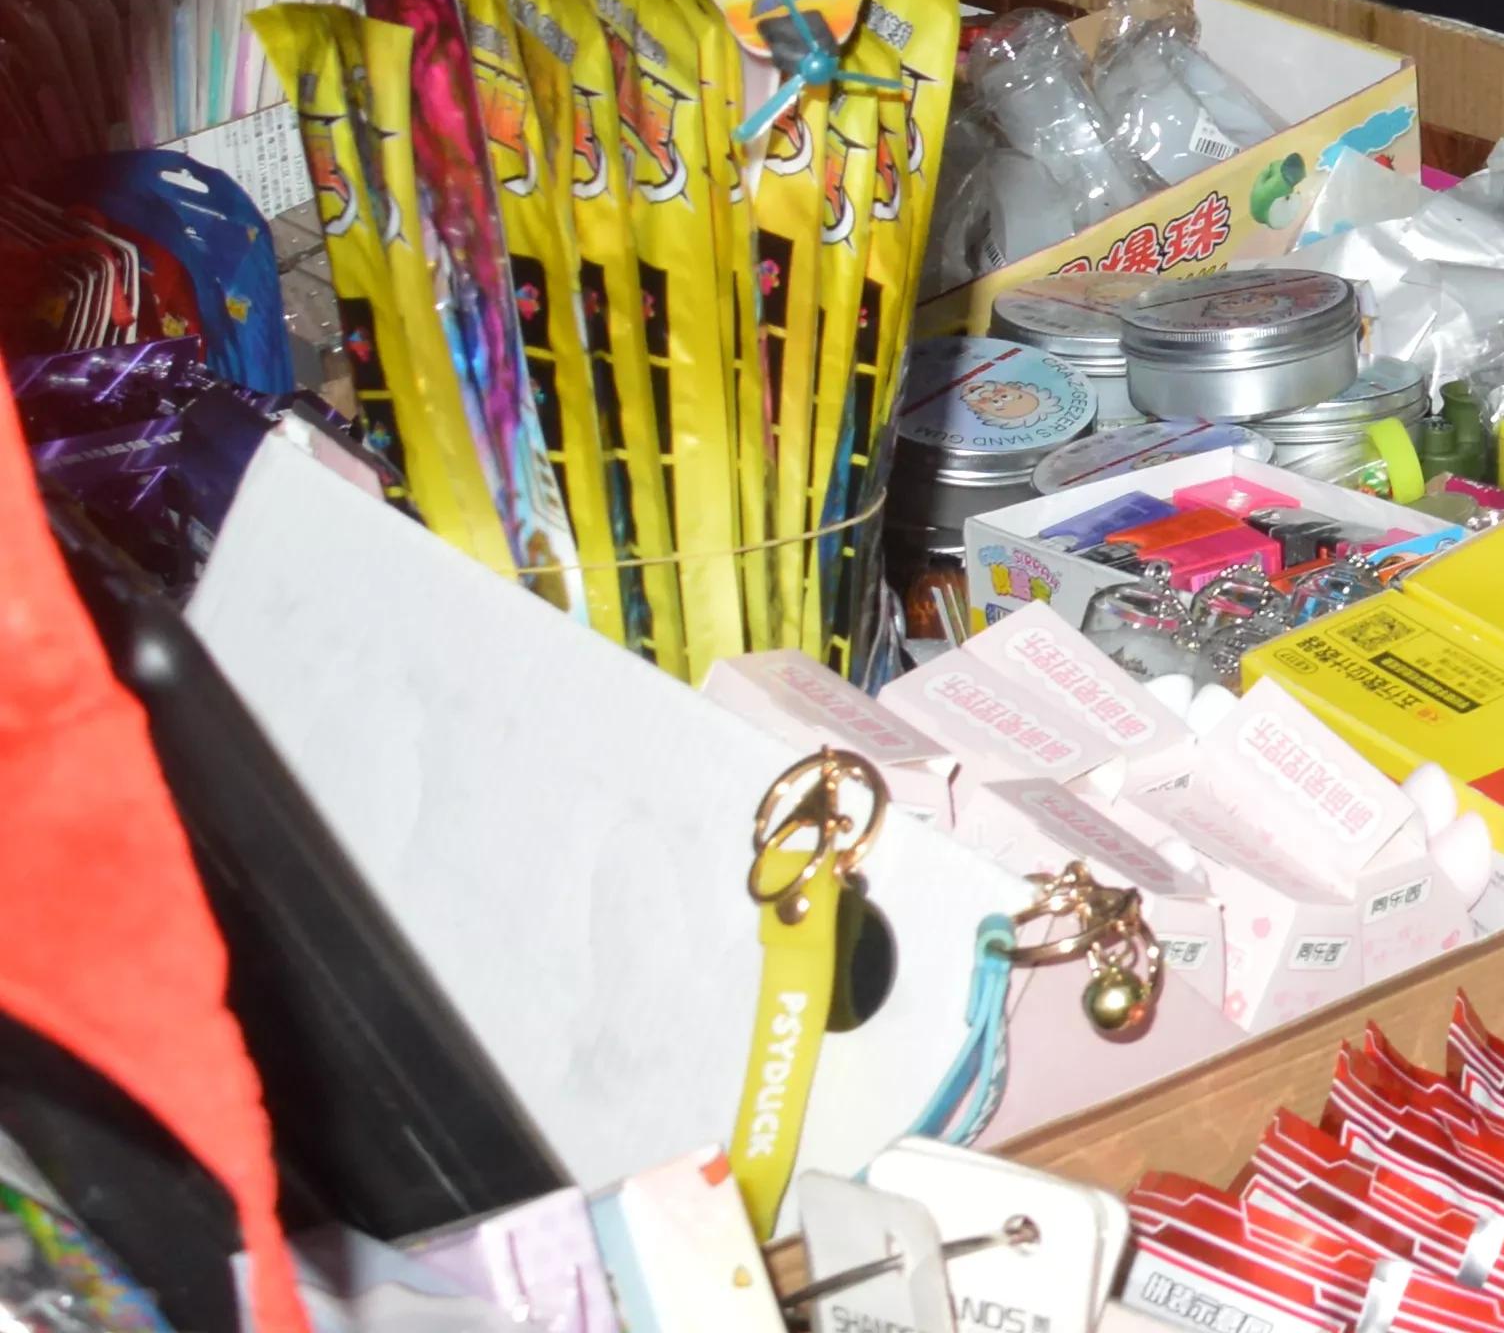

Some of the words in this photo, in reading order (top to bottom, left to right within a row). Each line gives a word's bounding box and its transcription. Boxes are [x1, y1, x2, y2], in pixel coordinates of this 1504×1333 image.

[1296, 635, 1425, 713] 五行数位计数器
[1372, 886, 1426, 915] 同乐园
[1296, 944, 1347, 964] 同乐园
[746, 990, 807, 1159] PSYDUCK
